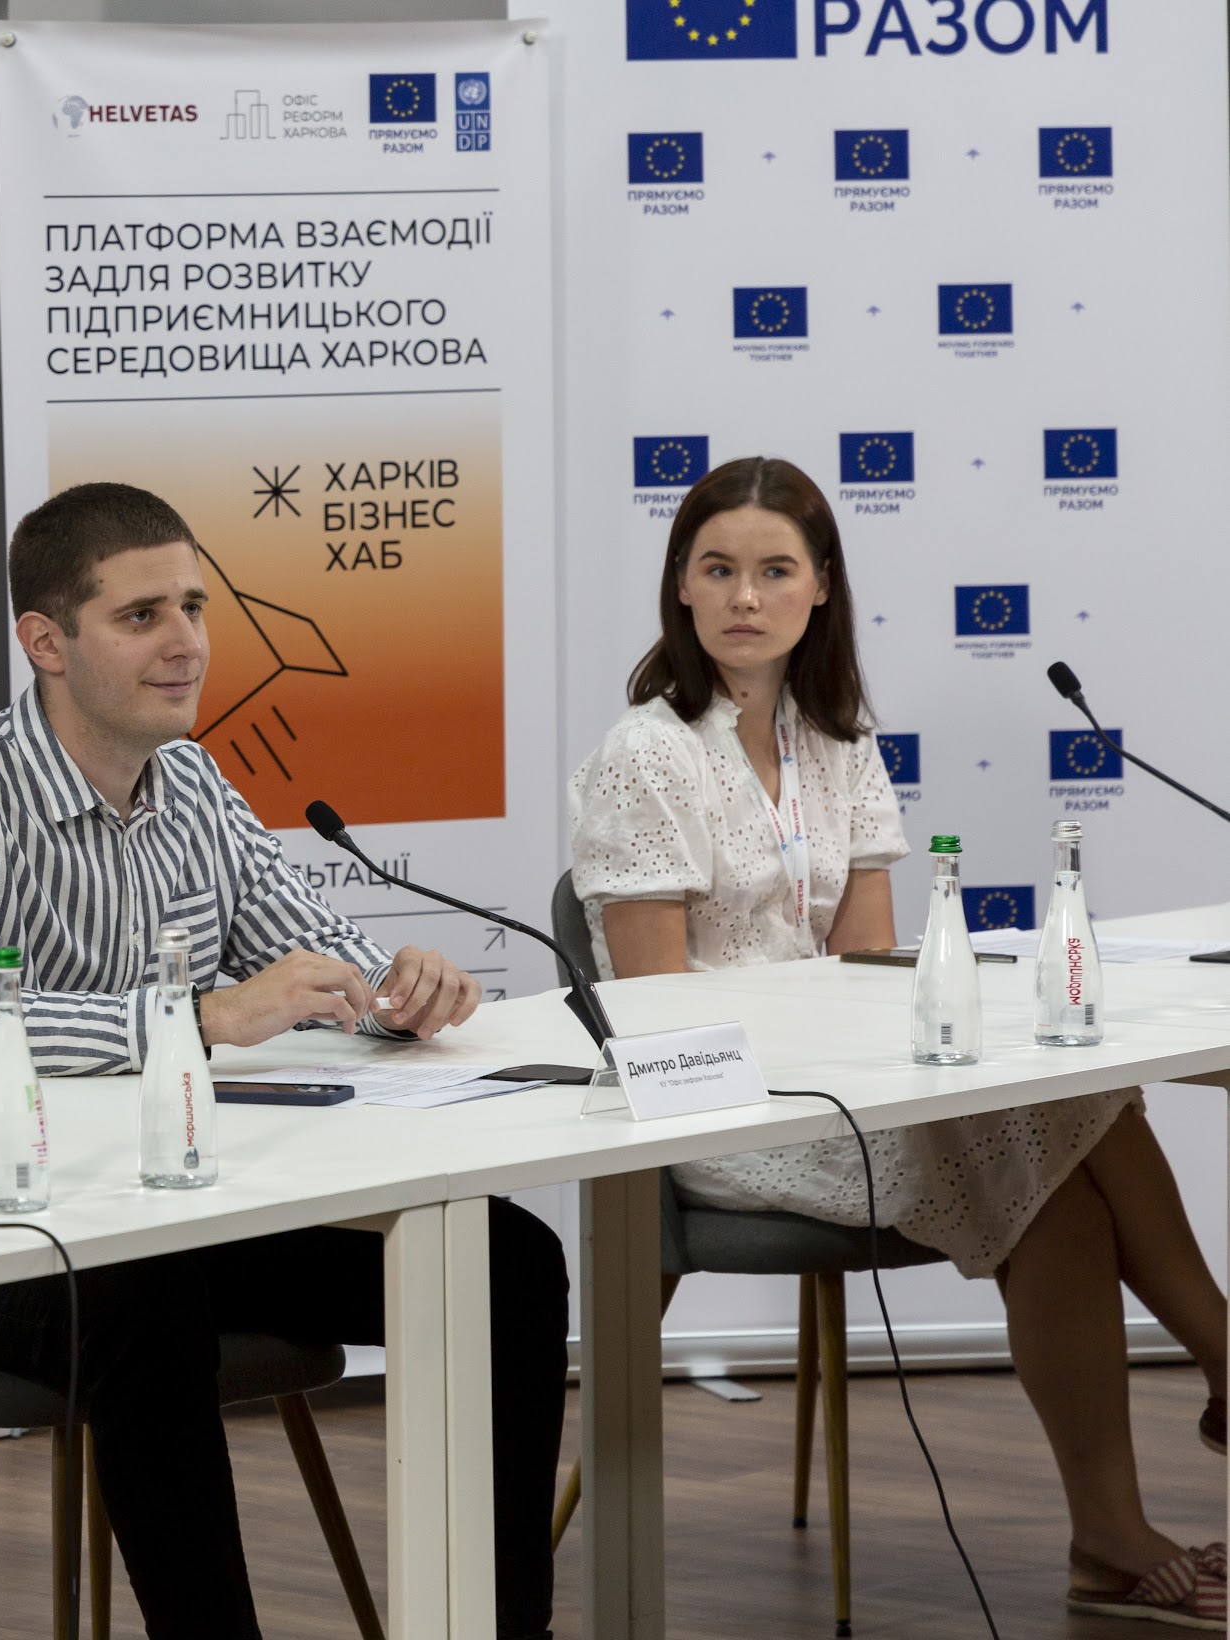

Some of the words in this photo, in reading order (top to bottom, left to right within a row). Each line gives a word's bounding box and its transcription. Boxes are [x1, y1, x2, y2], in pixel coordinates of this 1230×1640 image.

[812, 0, 1110, 56] РАЗОМ
[282, 94, 318, 106] ОФІС
[88, 105, 198, 122] HELVETAS
[283, 110, 343, 123] РЕФОРМ
[458, 115, 488, 130] UN
[283, 127, 347, 139] ХАРКОВА
[369, 129, 438, 139] ПРЯМУЄМО
[383, 143, 423, 153] РАЗОМ
[459, 134, 487, 150] DP
[627, 189, 704, 201] ПРЯМУЄМО
[834, 186, 910, 198] ПРЯМУЄМО
[1039, 184, 1114, 195] ПРЯМУЄМО
[643, 204, 689, 215] РАЗОМ
[850, 201, 895, 212] РАЗОМ
[1054, 198, 1098, 209] РАЗОМ
[47, 222, 284, 251] ПЛАТФОРМА
[297, 212, 492, 250] ВЗАЄМОДІЇ
[46, 264, 169, 297] ЗАДЛЯ
[184, 261, 371, 290] РОЗВИТКУ
[48, 299, 446, 338] ПІДПРИЄМНИЦЬКОГО
[47, 343, 310, 378] СЕРЕДОВИЩА
[322, 338, 487, 368] ХАРКОВА
[325, 459, 459, 492] ХАРКІВ
[840, 488, 915, 500] ПРЯМУЄМО
[1044, 484, 1118, 496] ПРЯМУЄМО
[633, 493, 685, 504] ПРЯМУ
[855, 503, 900, 514] РАЗОМ
[1059, 499, 1103, 511] РАЗОМ
[324, 499, 455, 532] БІЗНЕС
[650, 507, 675, 518] РАЗ
[326, 540, 402, 571] ХАБ
[1049, 785, 1124, 798] ПРЯМУЄМО
[1064, 800, 1109, 811] РАЗОМ
[291, 852, 411, 890] ЬТАЦІЇ
[627, 1058, 676, 1079] Дмитро
[678, 1049, 743, 1071] Давідьянц
[182, 1072, 196, 1147] моршинська
